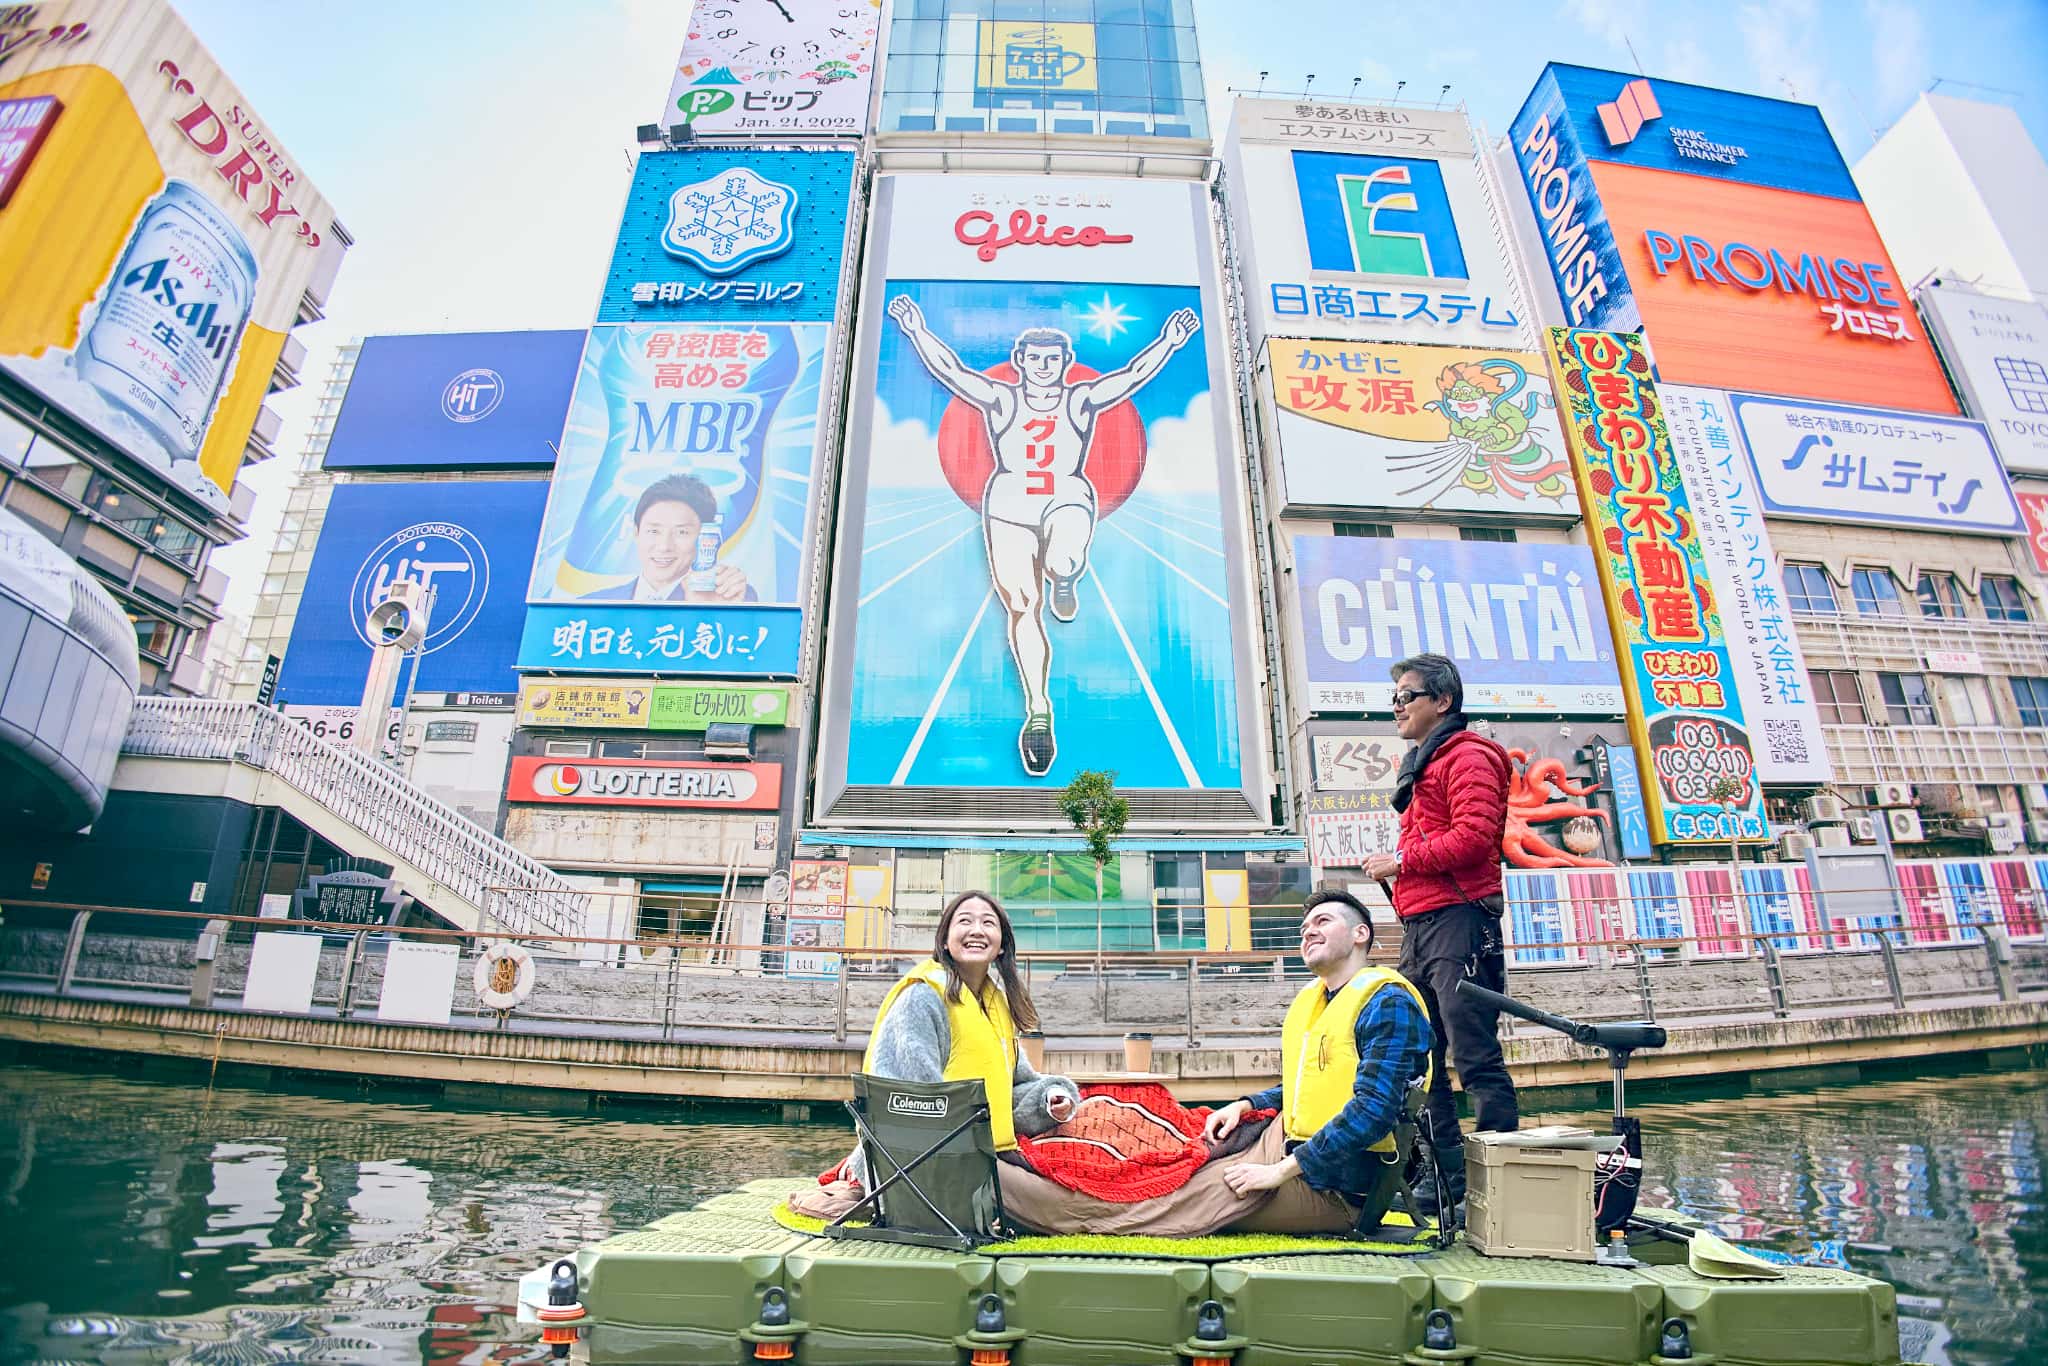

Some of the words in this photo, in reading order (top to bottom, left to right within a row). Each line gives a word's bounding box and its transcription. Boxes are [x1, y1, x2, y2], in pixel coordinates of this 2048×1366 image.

[743, 90, 823, 112] ピップ
[1295, 104, 1410, 125] 夢ある住まい
[735, 117, 774, 129] Jan.
[808, 117, 856, 128] 2022
[1669, 126, 1707, 142] SMBC
[226, 104, 296, 189] SUPER
[1674, 137, 1749, 158] CONSUMER
[1678, 146, 1738, 166] FINANCE
[1520, 112, 1608, 327] PROMISE
[1641, 229, 1902, 308] PROMISE
[631, 281, 804, 303] 雪印メグミルク
[1270, 283, 1519, 328] 日商エステム
[123, 258, 232, 360] Asahi
[1819, 304, 1916, 342] プロミス
[151, 320, 184, 357] 生
[645, 332, 768, 359] 骨密度を
[1295, 348, 1401, 374] かぜに
[654, 363, 748, 389] 高める
[128, 382, 158, 412] 350ml
[1285, 375, 1419, 416] 改源
[629, 402, 756, 454] MBP
[1023, 415, 1058, 496] グリコ
[1686, 418, 1721, 509] FOUNDATION
[1578, 335, 1700, 638] ひまわり不動産
[1822, 453, 1947, 498] サムティ
[396, 525, 464, 543] DOTONBORI
[1714, 514, 1729, 534] OF
[1695, 399, 1806, 705] 丸善インテック株式会社
[1721, 540, 1739, 568] THE
[1731, 574, 1755, 630] WORLD
[1645, 650, 1719, 678] ひまわり
[1751, 650, 1774, 705] JAPAN
[470, 694, 504, 706] Toilets
[693, 692, 747, 717] ピタットハウス
[1319, 689, 1367, 704] 天気予報
[1654, 680, 1726, 708] 不動産
[1682, 725, 1716, 748] 06
[1596, 745, 1609, 777] 2F
[1660, 749, 1748, 776] (6641)
[588, 768, 736, 798] LOTTERIA
[1317, 819, 1400, 857] 大阪に乾
[892, 1094, 936, 1112] Coleman
